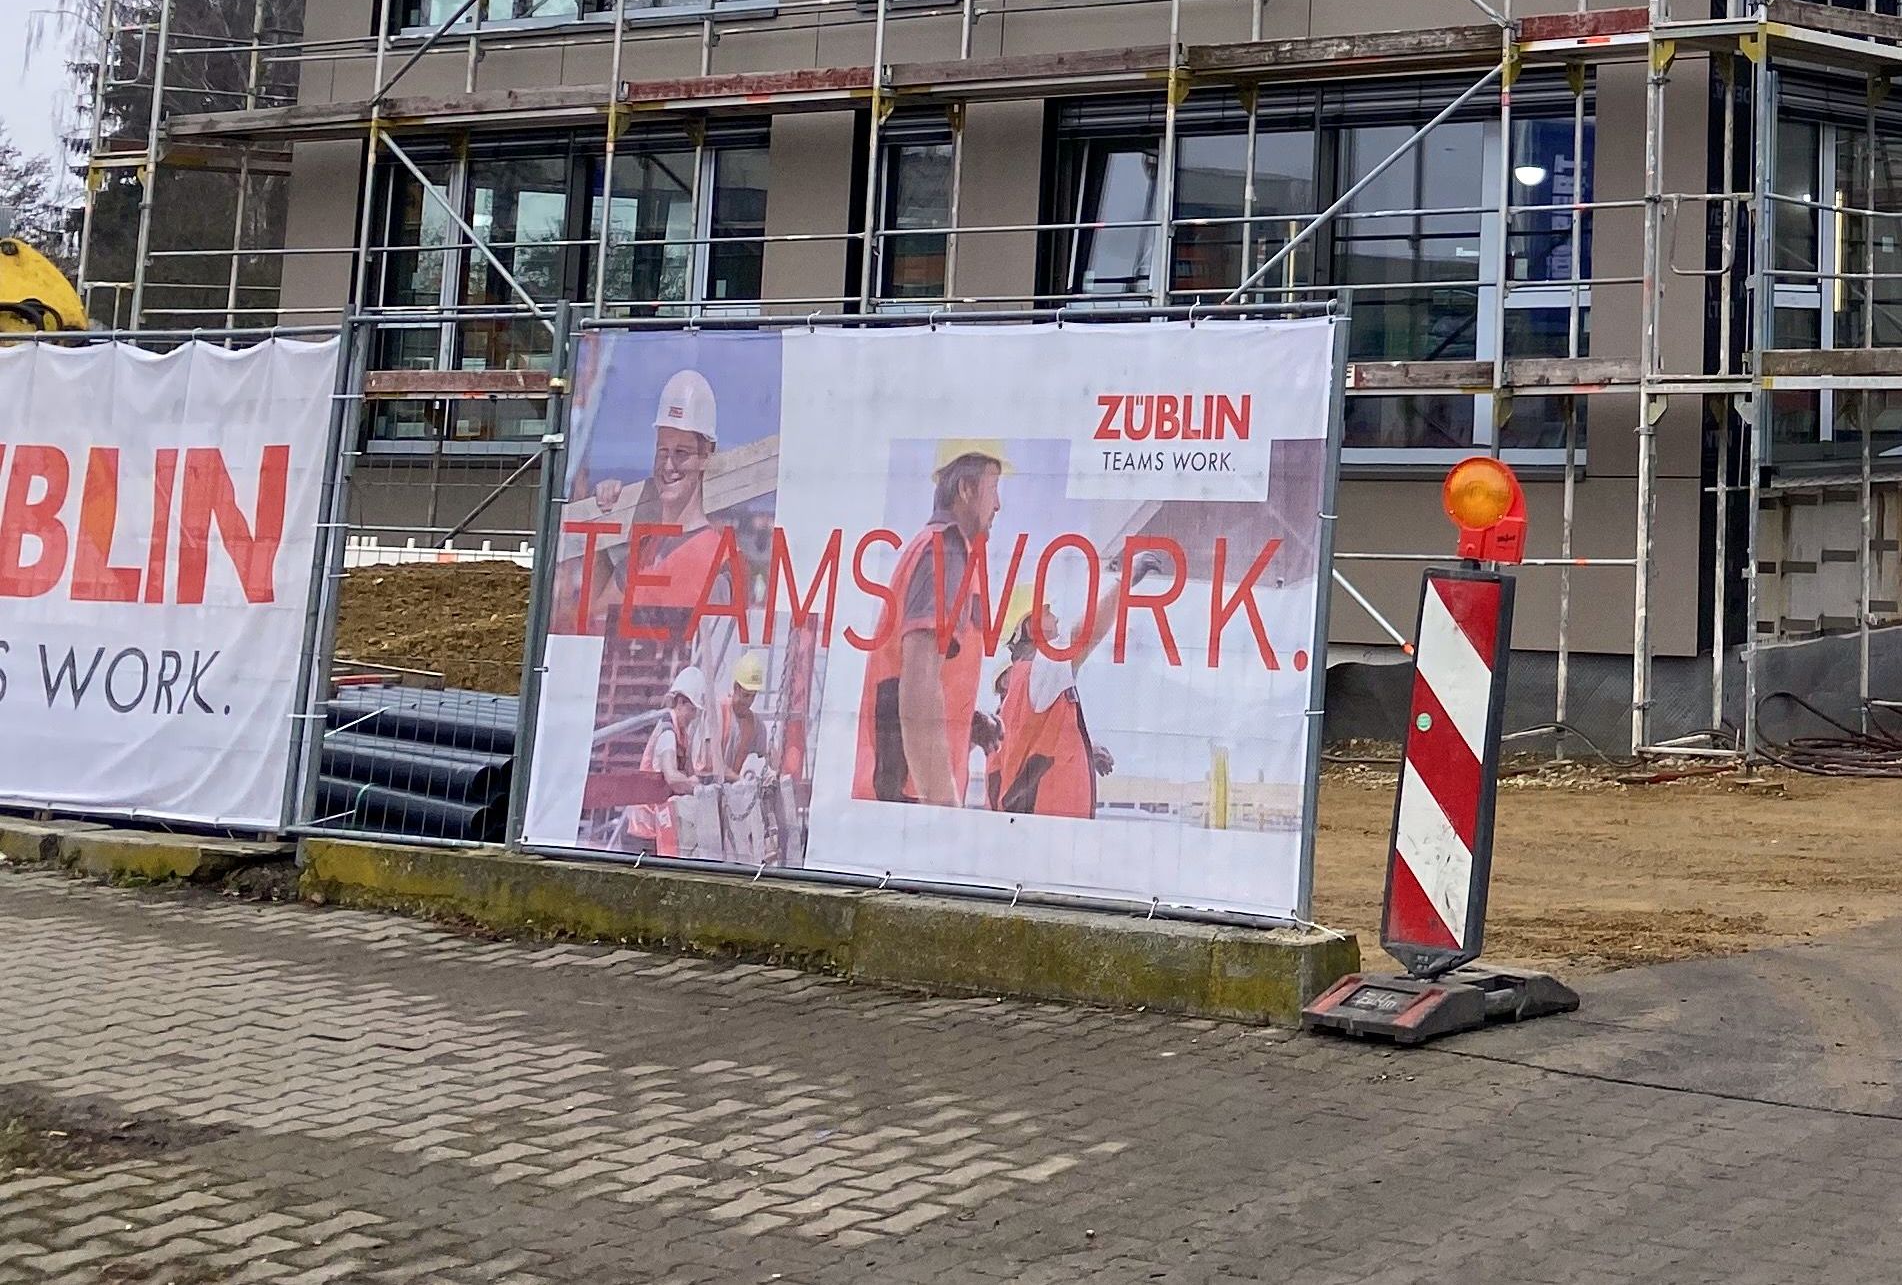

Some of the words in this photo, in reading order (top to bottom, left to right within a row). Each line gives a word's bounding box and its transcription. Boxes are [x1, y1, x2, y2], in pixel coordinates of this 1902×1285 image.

[1094, 395, 1251, 441] ZÜBLIN
[1102, 452, 1165, 471] TEAMS
[1173, 452, 1236, 472] WORK.
[563, 521, 903, 653] TEAMS
[934, 532, 1309, 674] WORK.
[39, 644, 231, 715] WORK.
